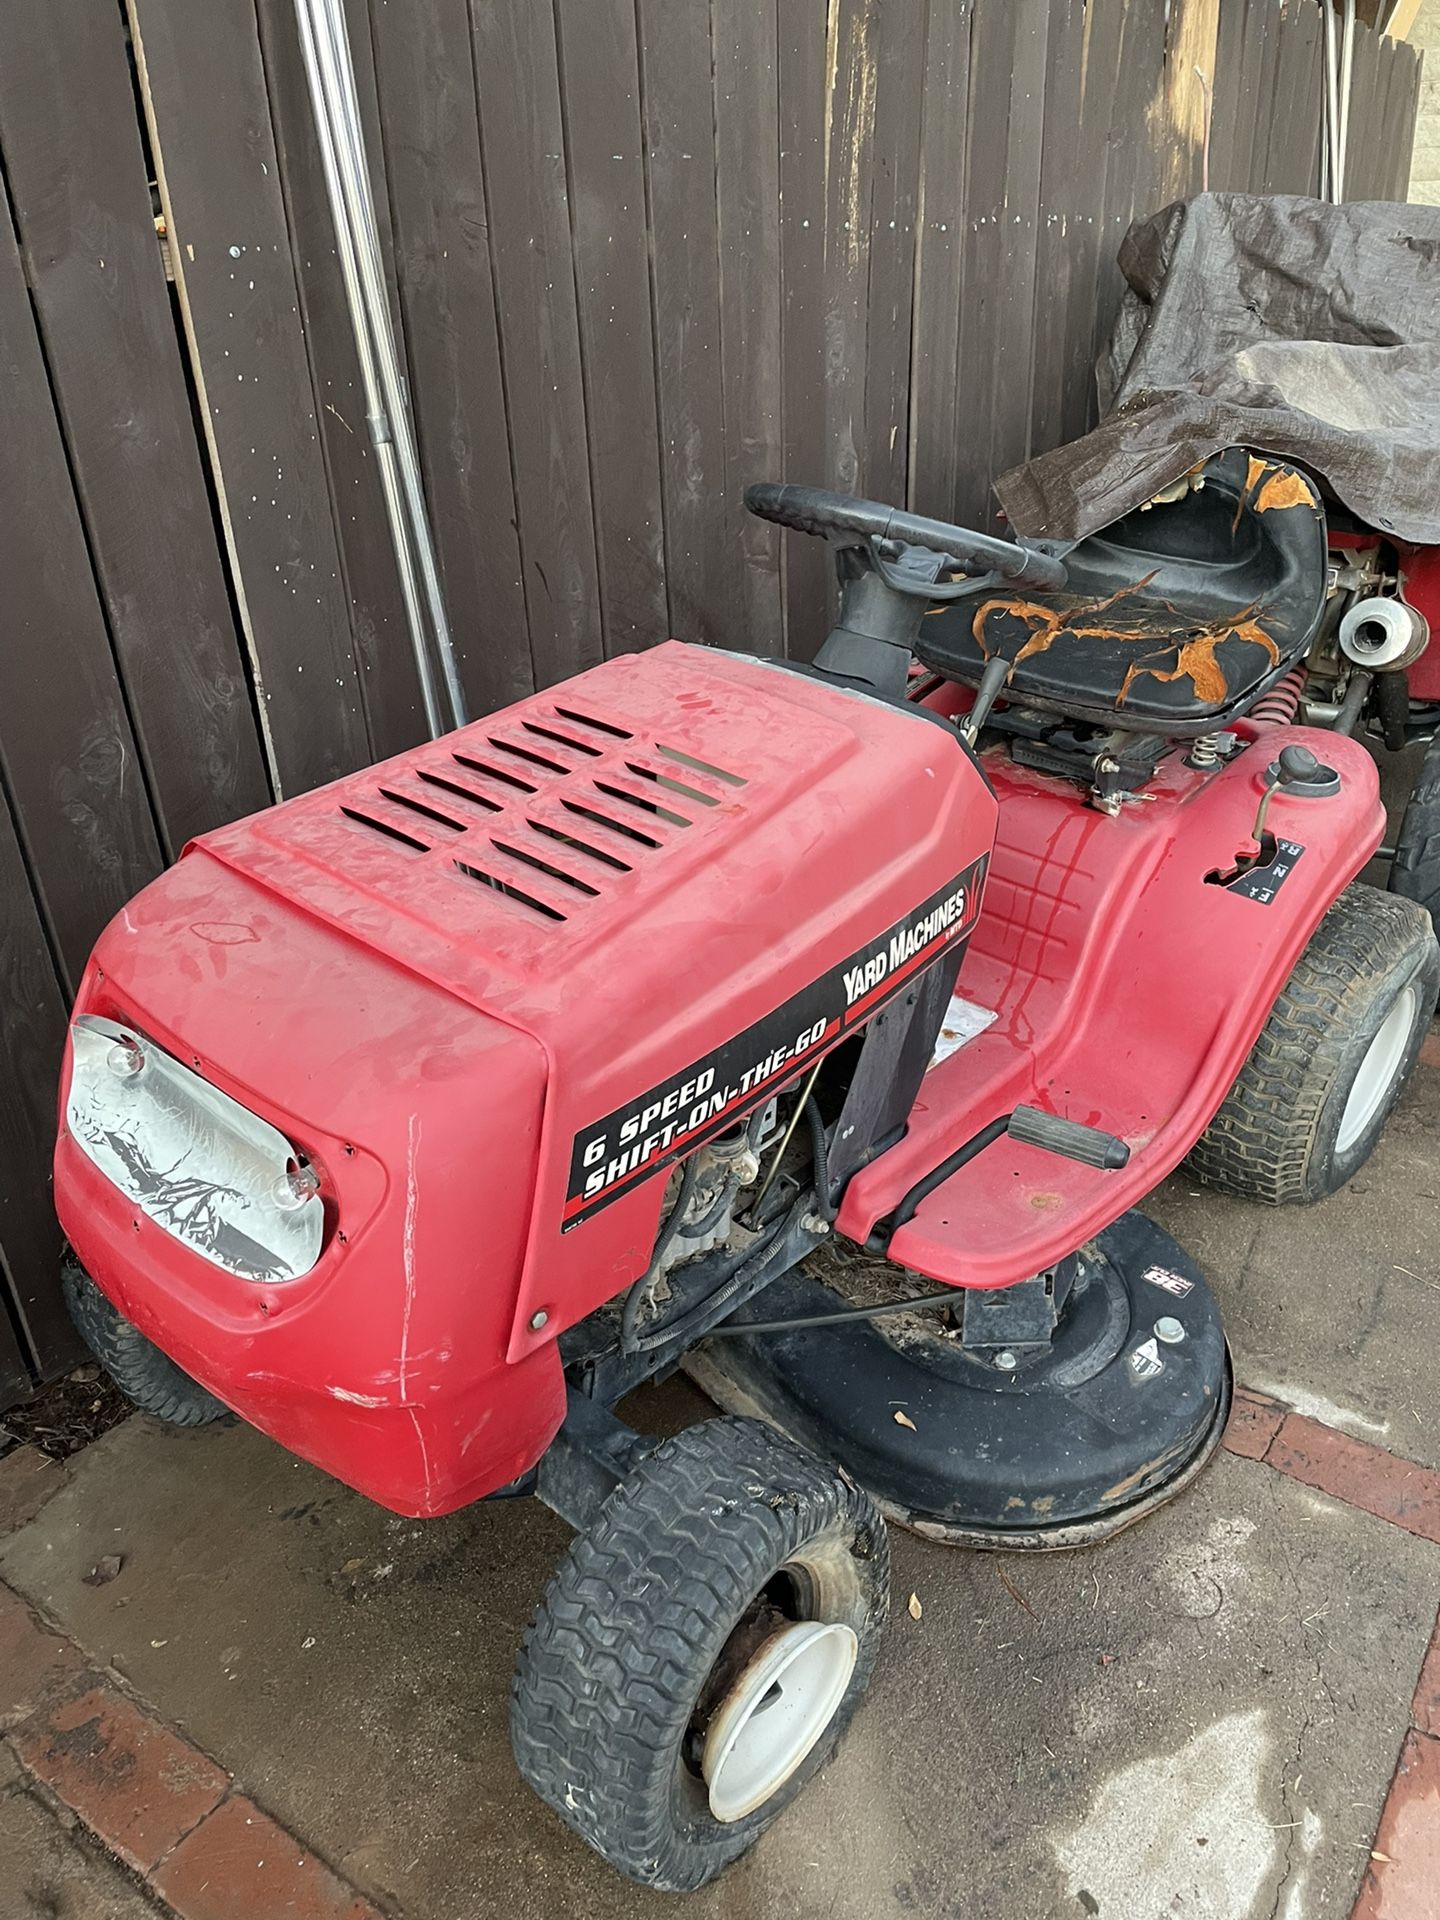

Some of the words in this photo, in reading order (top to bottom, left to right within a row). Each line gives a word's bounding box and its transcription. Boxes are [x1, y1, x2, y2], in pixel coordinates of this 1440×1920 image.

[1287, 846, 1301, 856] R
[1273, 866, 1286, 877] N
[1258, 893, 1271, 902] F
[842, 951, 887, 1006] YARD
[889, 888, 965, 972] MACHINES
[582, 1134, 607, 1168] 6
[619, 1067, 716, 1146] SPEED
[583, 1016, 828, 1199] SHIFT-ON-THE-GO
[1143, 1270, 1188, 1294] 38
